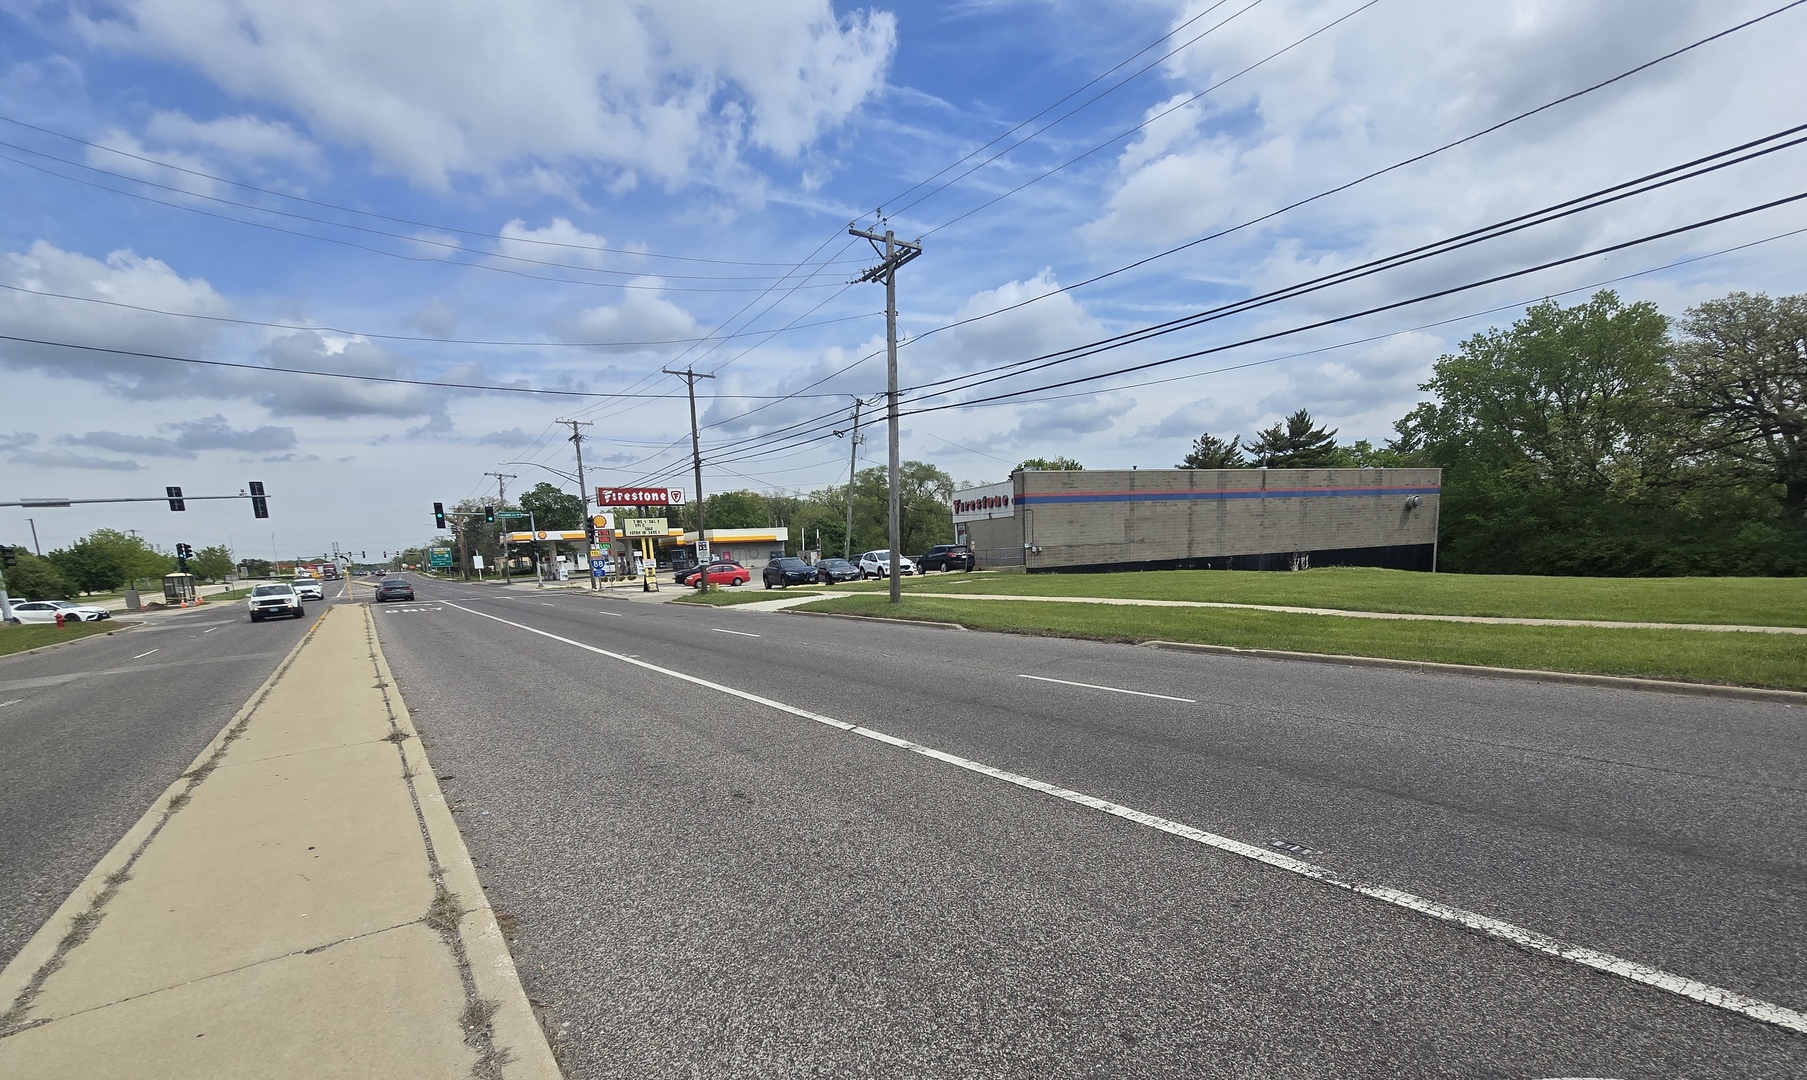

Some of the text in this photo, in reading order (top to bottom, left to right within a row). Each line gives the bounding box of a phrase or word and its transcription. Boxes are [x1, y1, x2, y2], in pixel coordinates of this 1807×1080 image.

[602, 490, 667, 503] Firestone
[953, 495, 1009, 514] Firestone
[593, 560, 604, 568] 88
